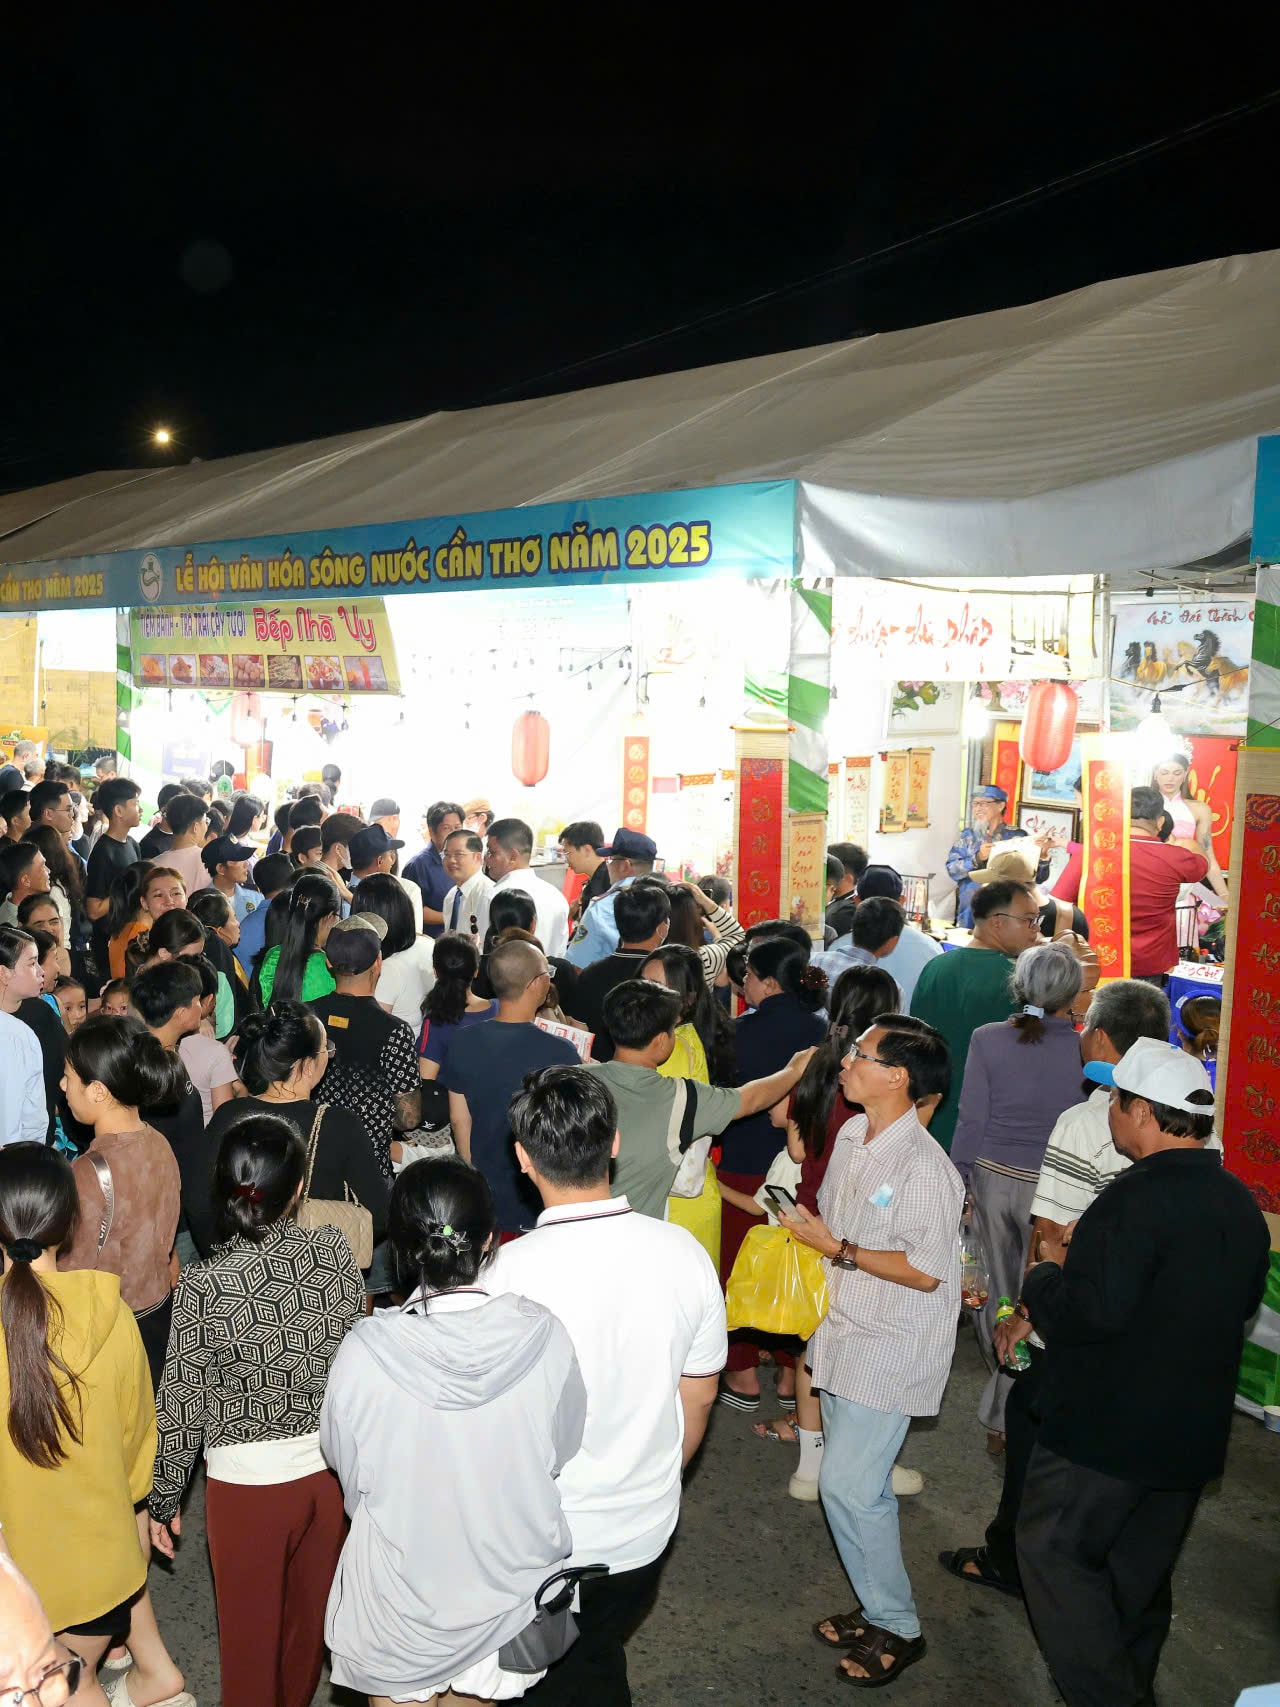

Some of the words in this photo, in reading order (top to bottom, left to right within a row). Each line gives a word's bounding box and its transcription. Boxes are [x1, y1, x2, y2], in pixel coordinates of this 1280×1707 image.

[175, 551, 195, 592] LỄ
[198, 555, 225, 599] HỘI
[229, 553, 263, 592] VĂN
[268, 547, 306, 589] HÓA
[310, 546, 367, 587] SÔNG
[370, 540, 430, 585] NƯỚC
[434, 525, 483, 582] CẦN
[488, 537, 543, 578] THƠ
[550, 521, 620, 574] NĂM
[625, 520, 712, 568] 2025
[73, 573, 105, 598] 2025
[252, 607, 293, 651] Bếp
[296, 606, 337, 642] Nhà
